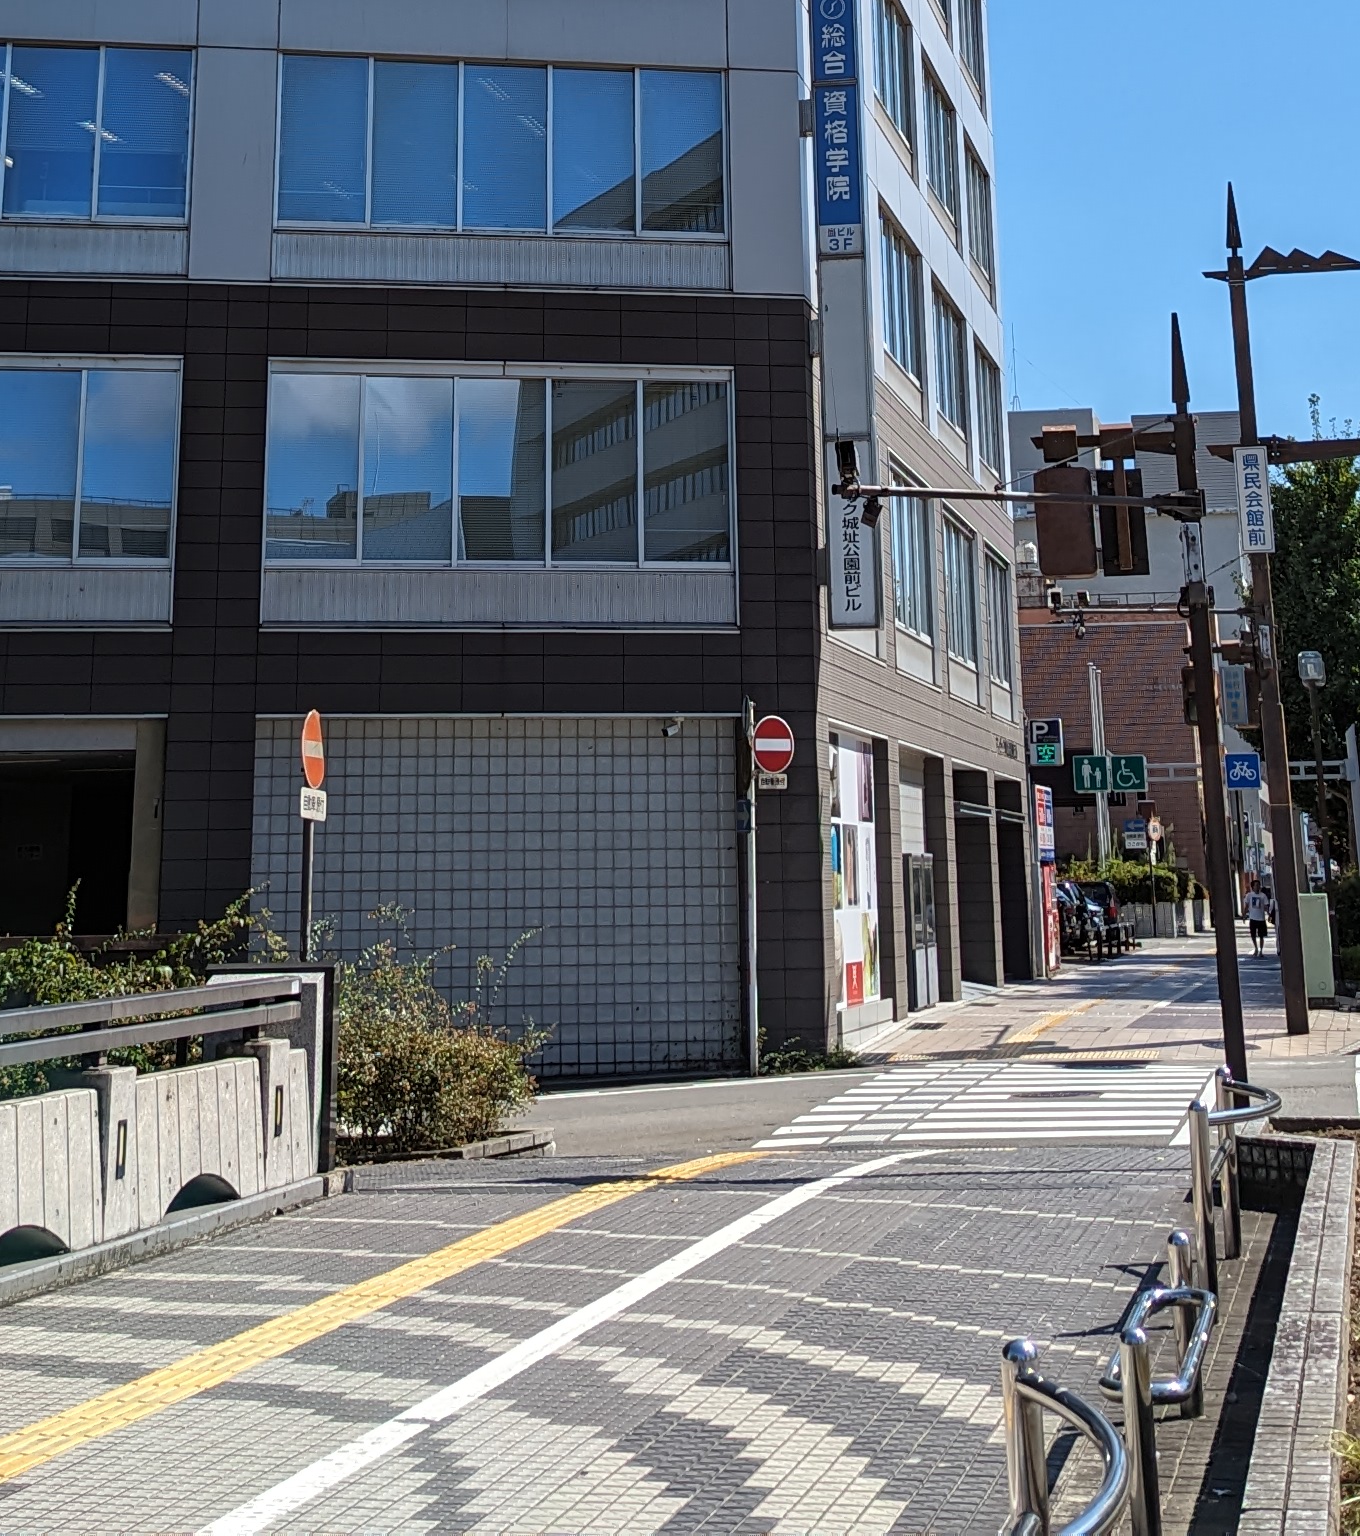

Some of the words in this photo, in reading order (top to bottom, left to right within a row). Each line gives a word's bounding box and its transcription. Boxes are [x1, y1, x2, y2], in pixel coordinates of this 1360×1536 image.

[829, 237, 853, 251] 3F
[1242, 453, 1266, 547] 県民会館前
[841, 498, 862, 612] ク城址公園前ビル
[1031, 721, 1049, 743] P
